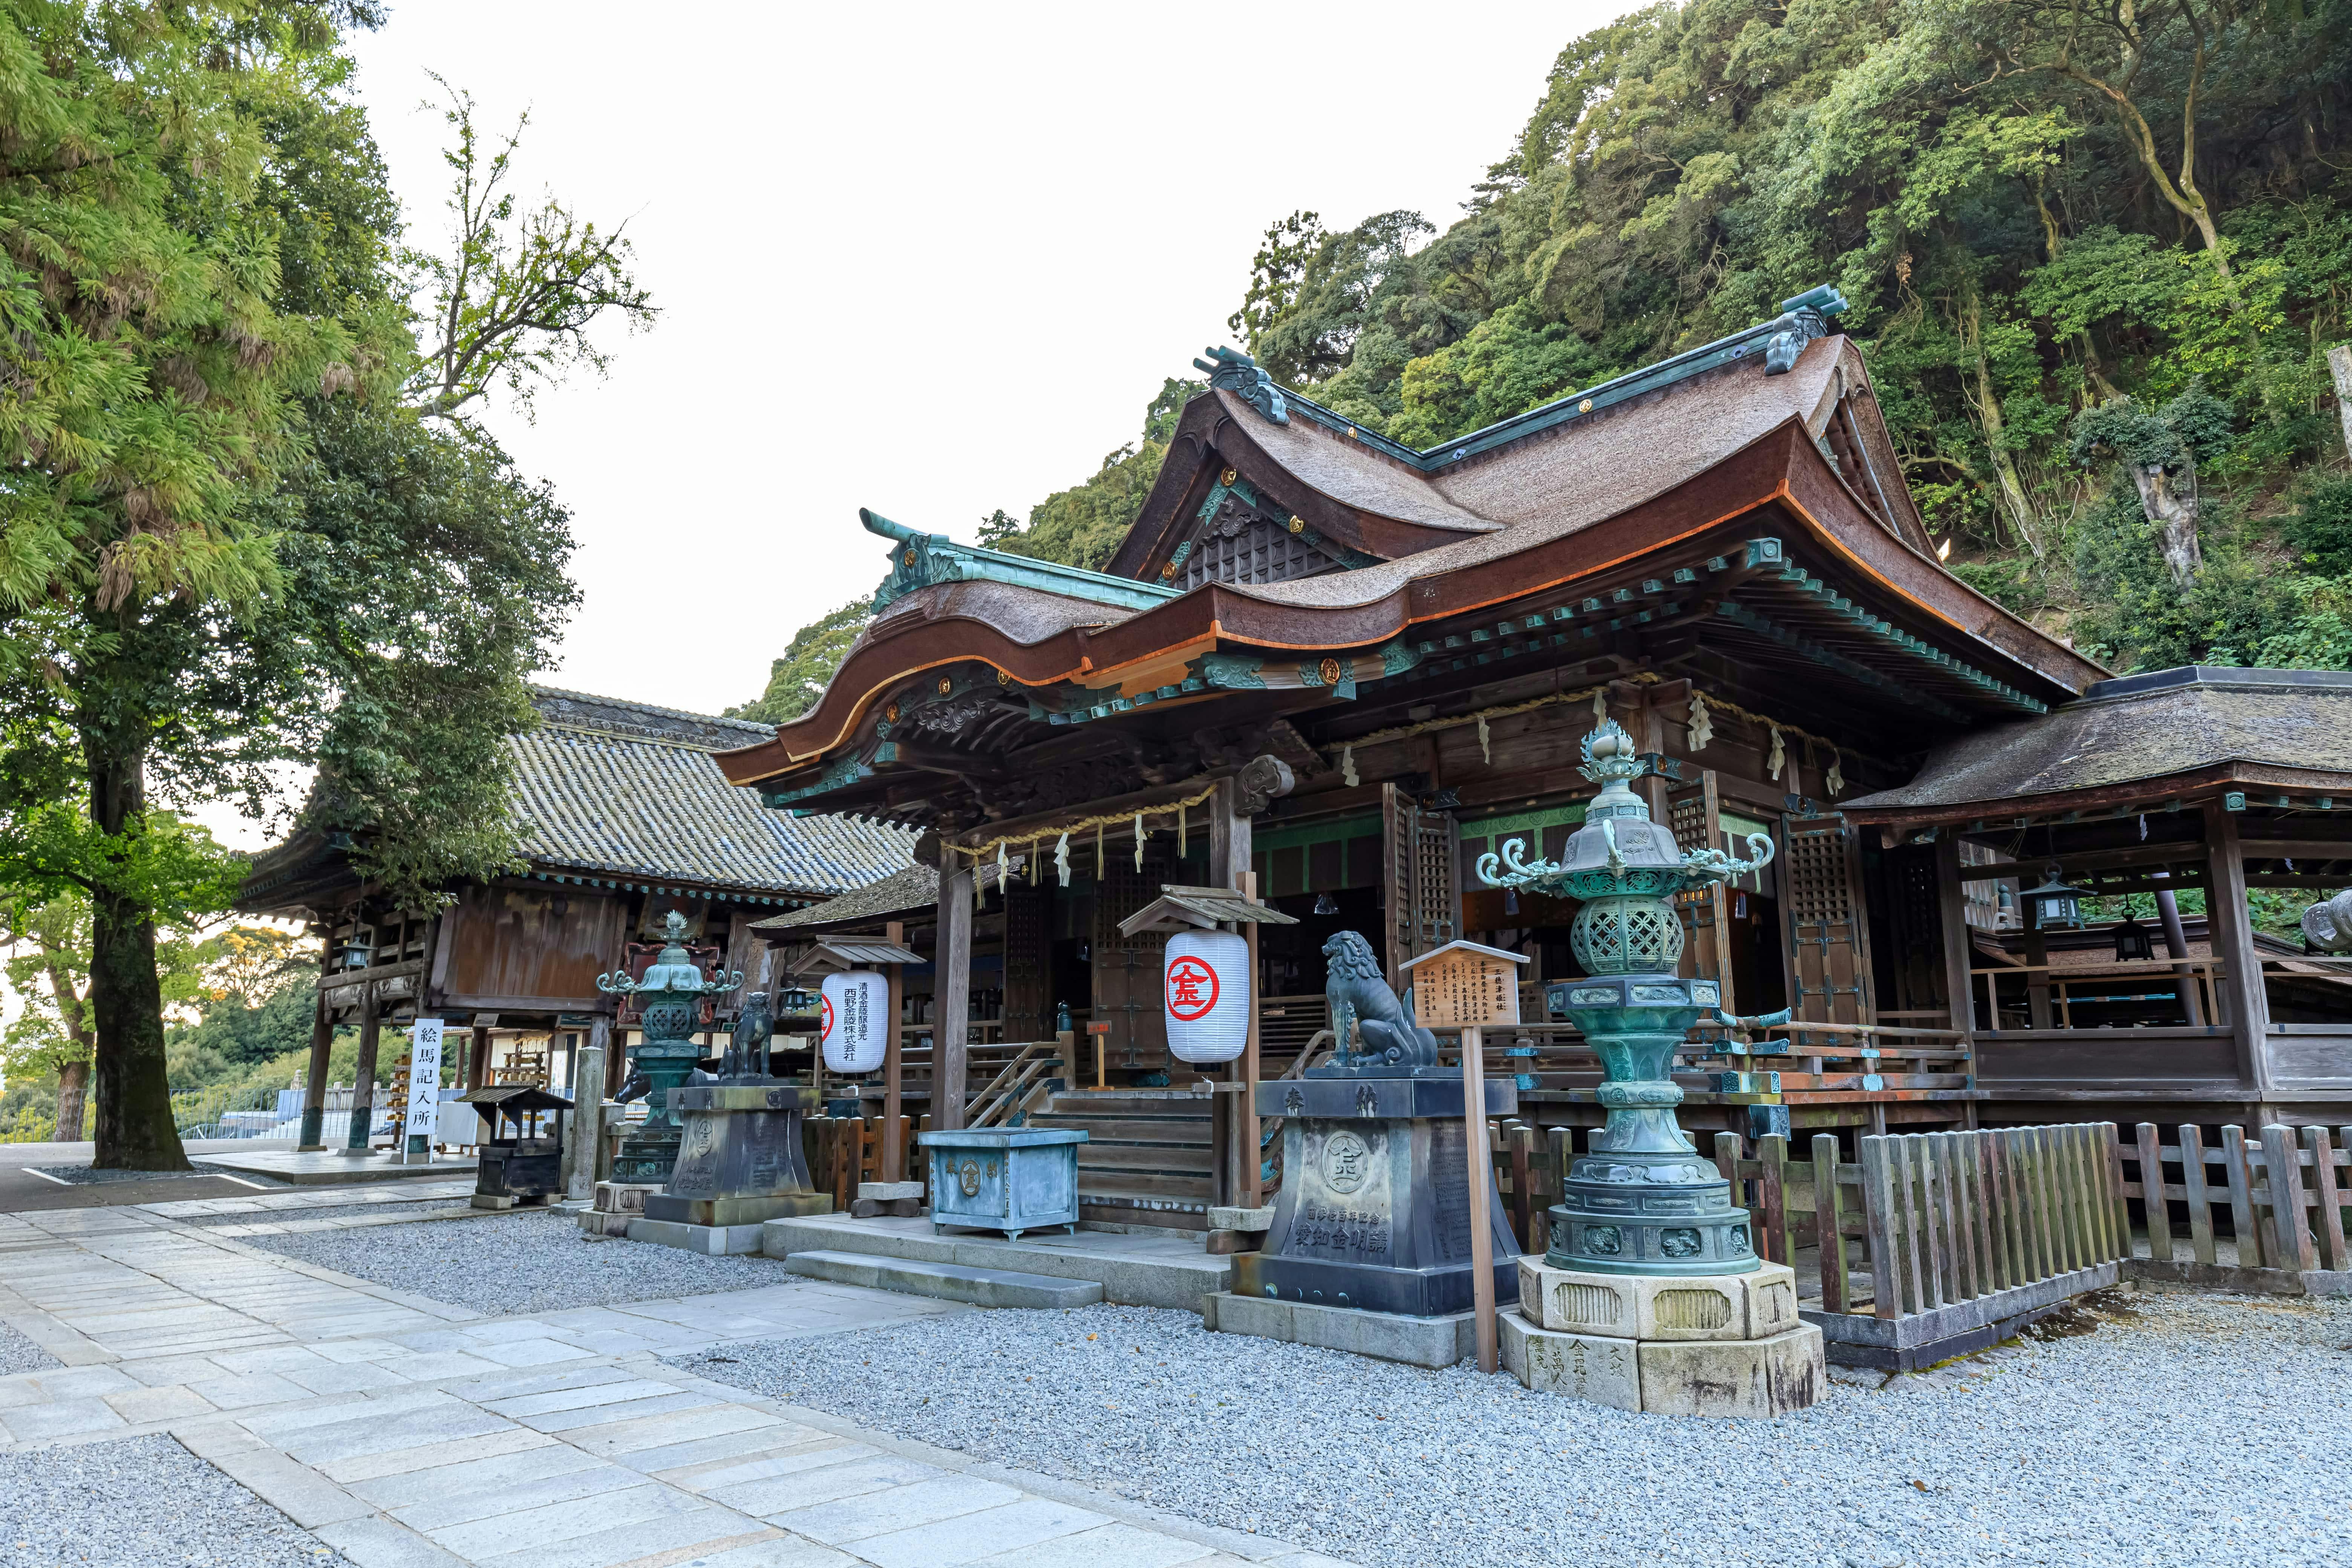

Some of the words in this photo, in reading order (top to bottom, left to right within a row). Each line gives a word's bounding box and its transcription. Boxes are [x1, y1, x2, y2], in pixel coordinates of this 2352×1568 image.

[858, 982, 868, 1040] 清酒金陵醸造元
[1170, 964, 1210, 1008] 金
[844, 988, 857, 1061] 西野金陵株式会社
[413, 1027, 437, 1126] 絵馬記入所
[1328, 1139, 1363, 1181] 金
[1295, 1223, 1387, 1253] 愛知金明講
